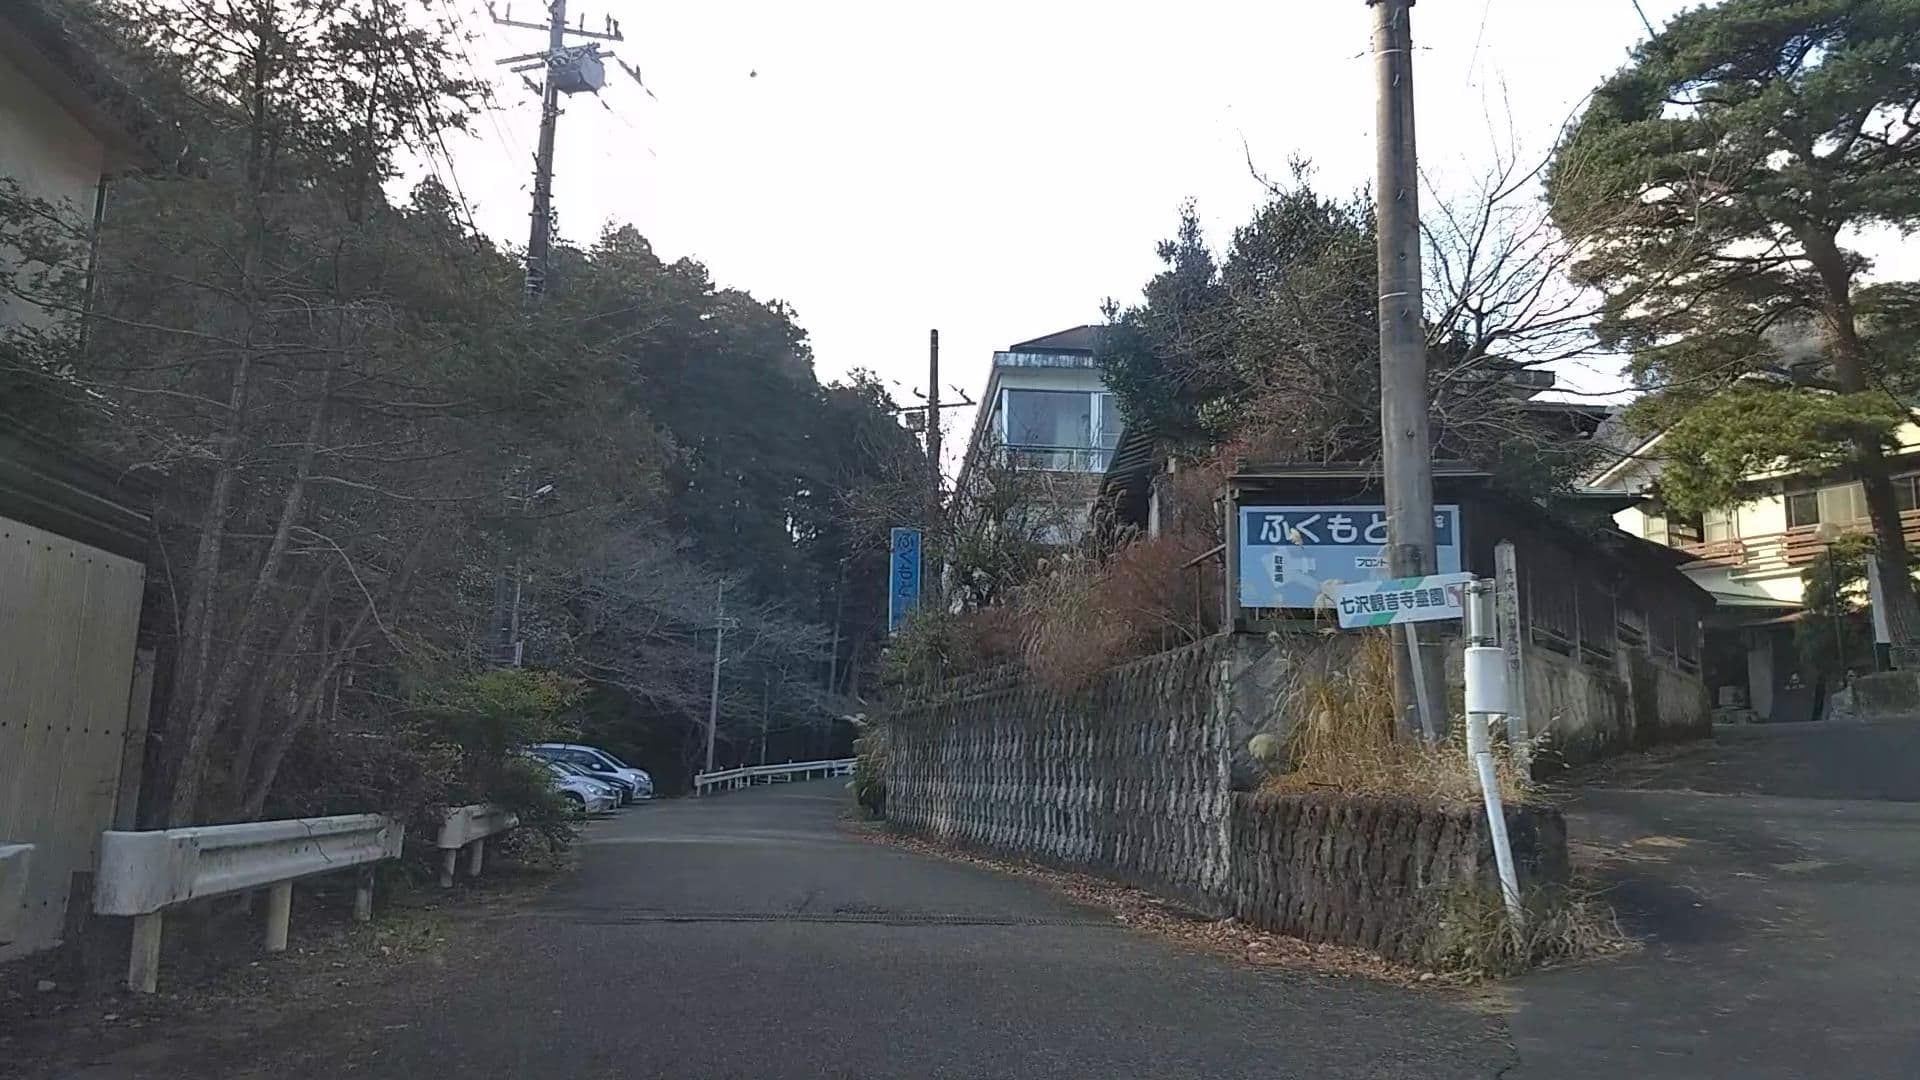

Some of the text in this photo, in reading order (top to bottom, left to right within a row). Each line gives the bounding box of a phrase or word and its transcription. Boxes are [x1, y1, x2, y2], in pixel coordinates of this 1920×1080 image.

[1357, 558, 1386, 567] フロント
[1340, 587, 1446, 615] 七沢観音寺霊園
